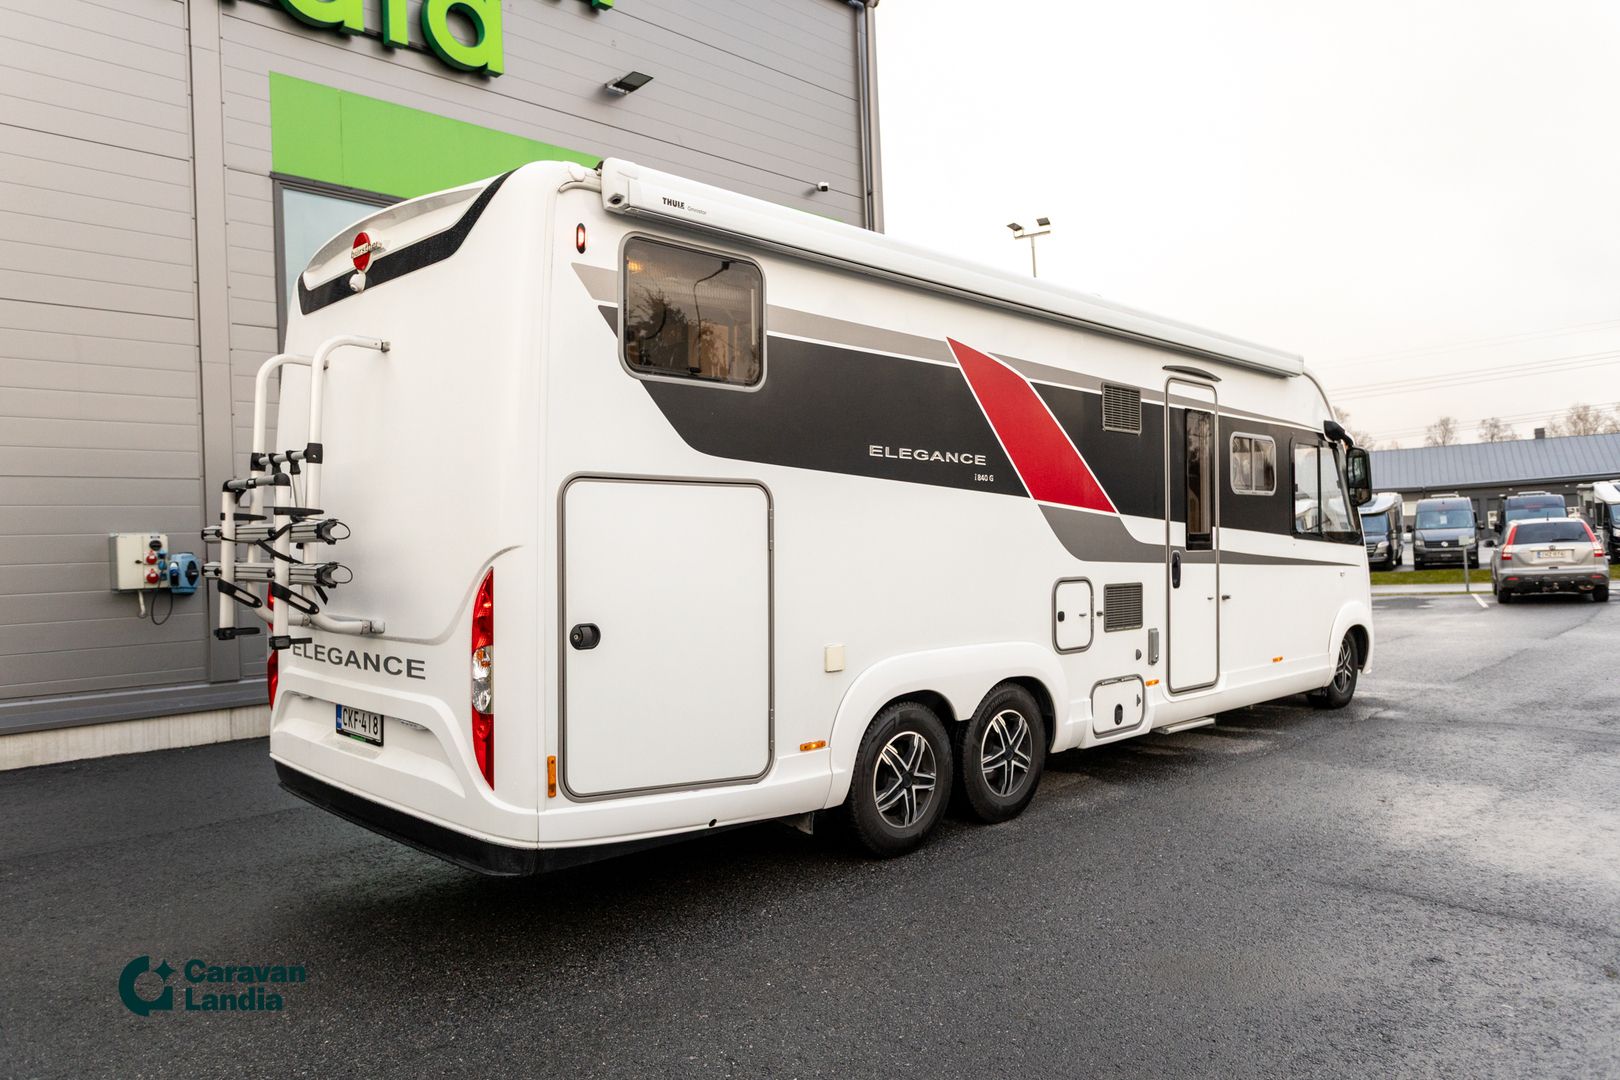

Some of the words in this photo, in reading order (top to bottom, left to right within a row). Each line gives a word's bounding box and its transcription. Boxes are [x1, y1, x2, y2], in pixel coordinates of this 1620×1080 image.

[662, 197, 685, 210] THULE
[869, 444, 987, 466] ELEGANCE
[292, 643, 426, 680] ELEGANCE
[342, 708, 379, 735] CKF-418
